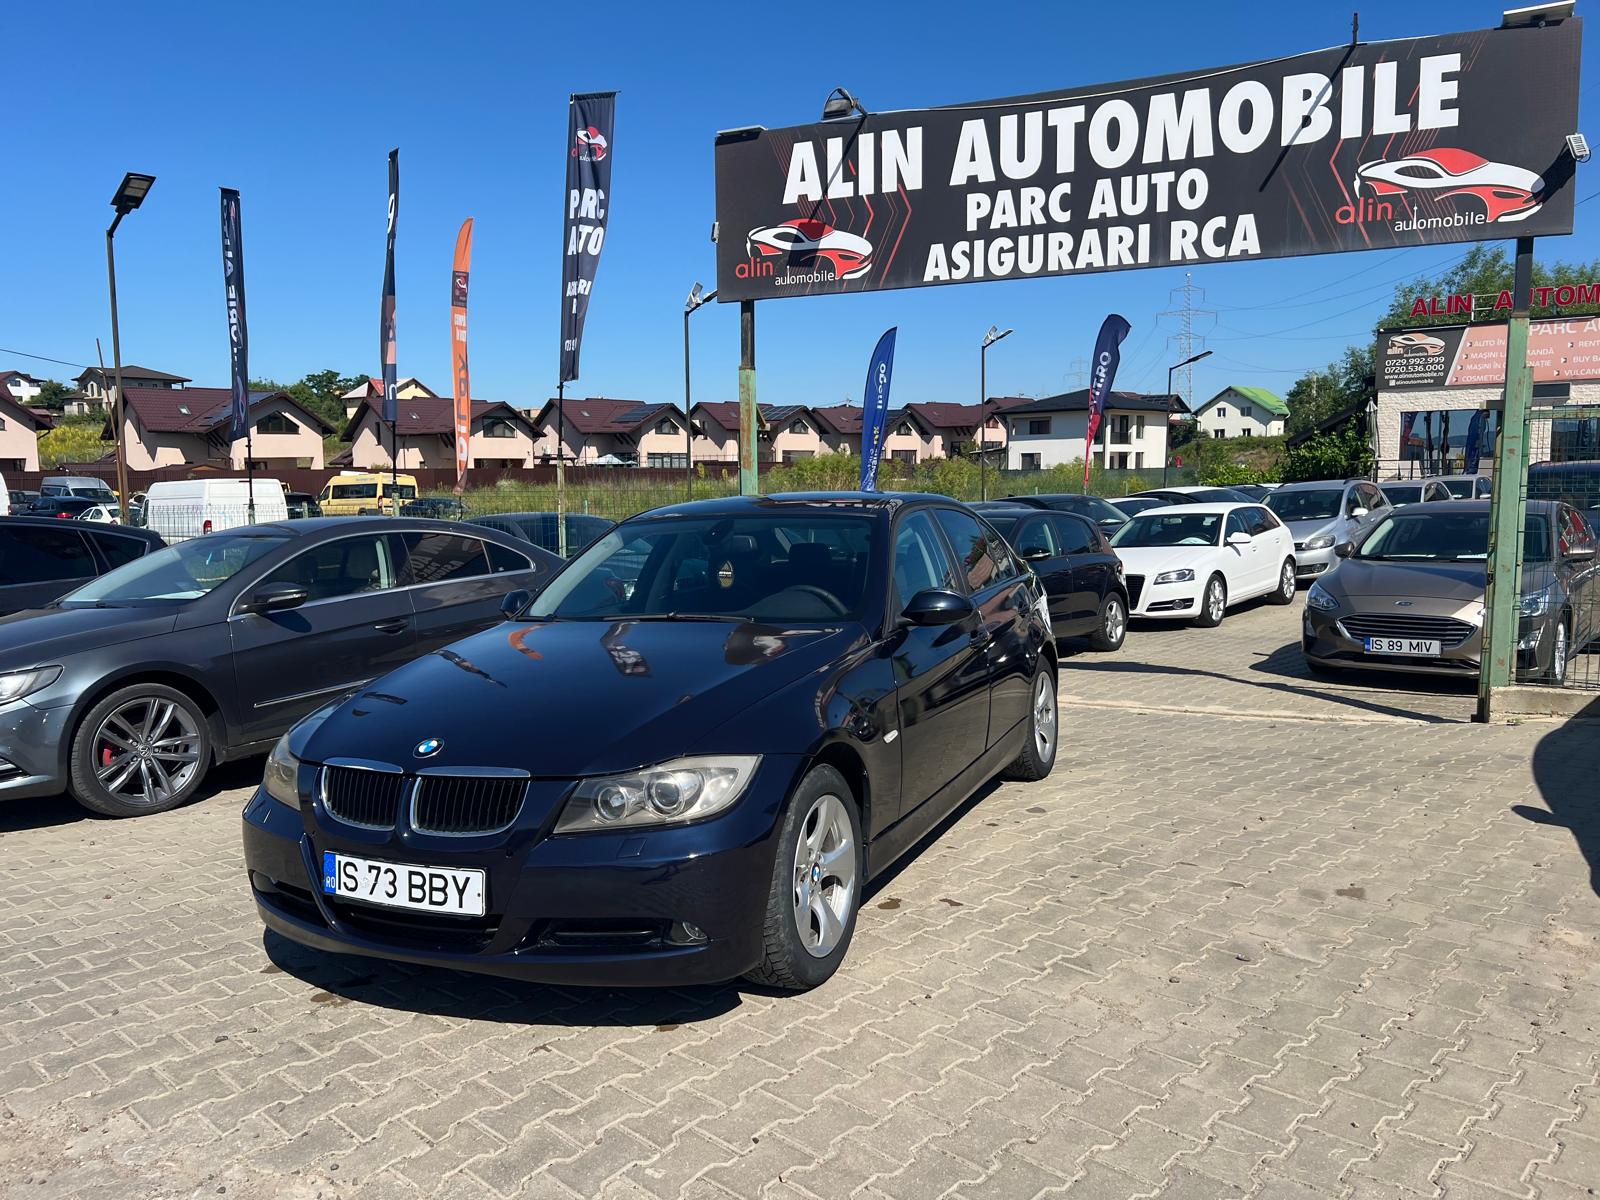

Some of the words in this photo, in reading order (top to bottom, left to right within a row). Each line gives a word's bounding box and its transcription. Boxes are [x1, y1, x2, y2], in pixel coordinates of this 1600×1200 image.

[782, 126, 923, 205] ALIN
[949, 53, 1462, 186] AUTOMOBILE
[966, 182, 1072, 232] PARC
[1087, 167, 1209, 220] AUTO
[1334, 197, 1394, 225] alin
[1393, 204, 1486, 231] automobile
[922, 223, 1152, 282] ASIGURARI
[1169, 213, 1261, 261] RCA
[735, 257, 774, 280] alin
[774, 265, 836, 286] automobile
[1410, 293, 1473, 317] ALIN
[1494, 283, 1600, 311] ATOM
[1583, 320, 1600, 334] A
[1384, 364, 1445, 374] 0720.536.000
[1385, 356, 1445, 367] 0729.992.999
[1371, 638, 1383, 651] IS
[1387, 640, 1403, 652] 89
[1408, 641, 1433, 653] MIV
[337, 860, 359, 892] IS
[367, 864, 398, 899] 73
[407, 870, 471, 909] BBY
